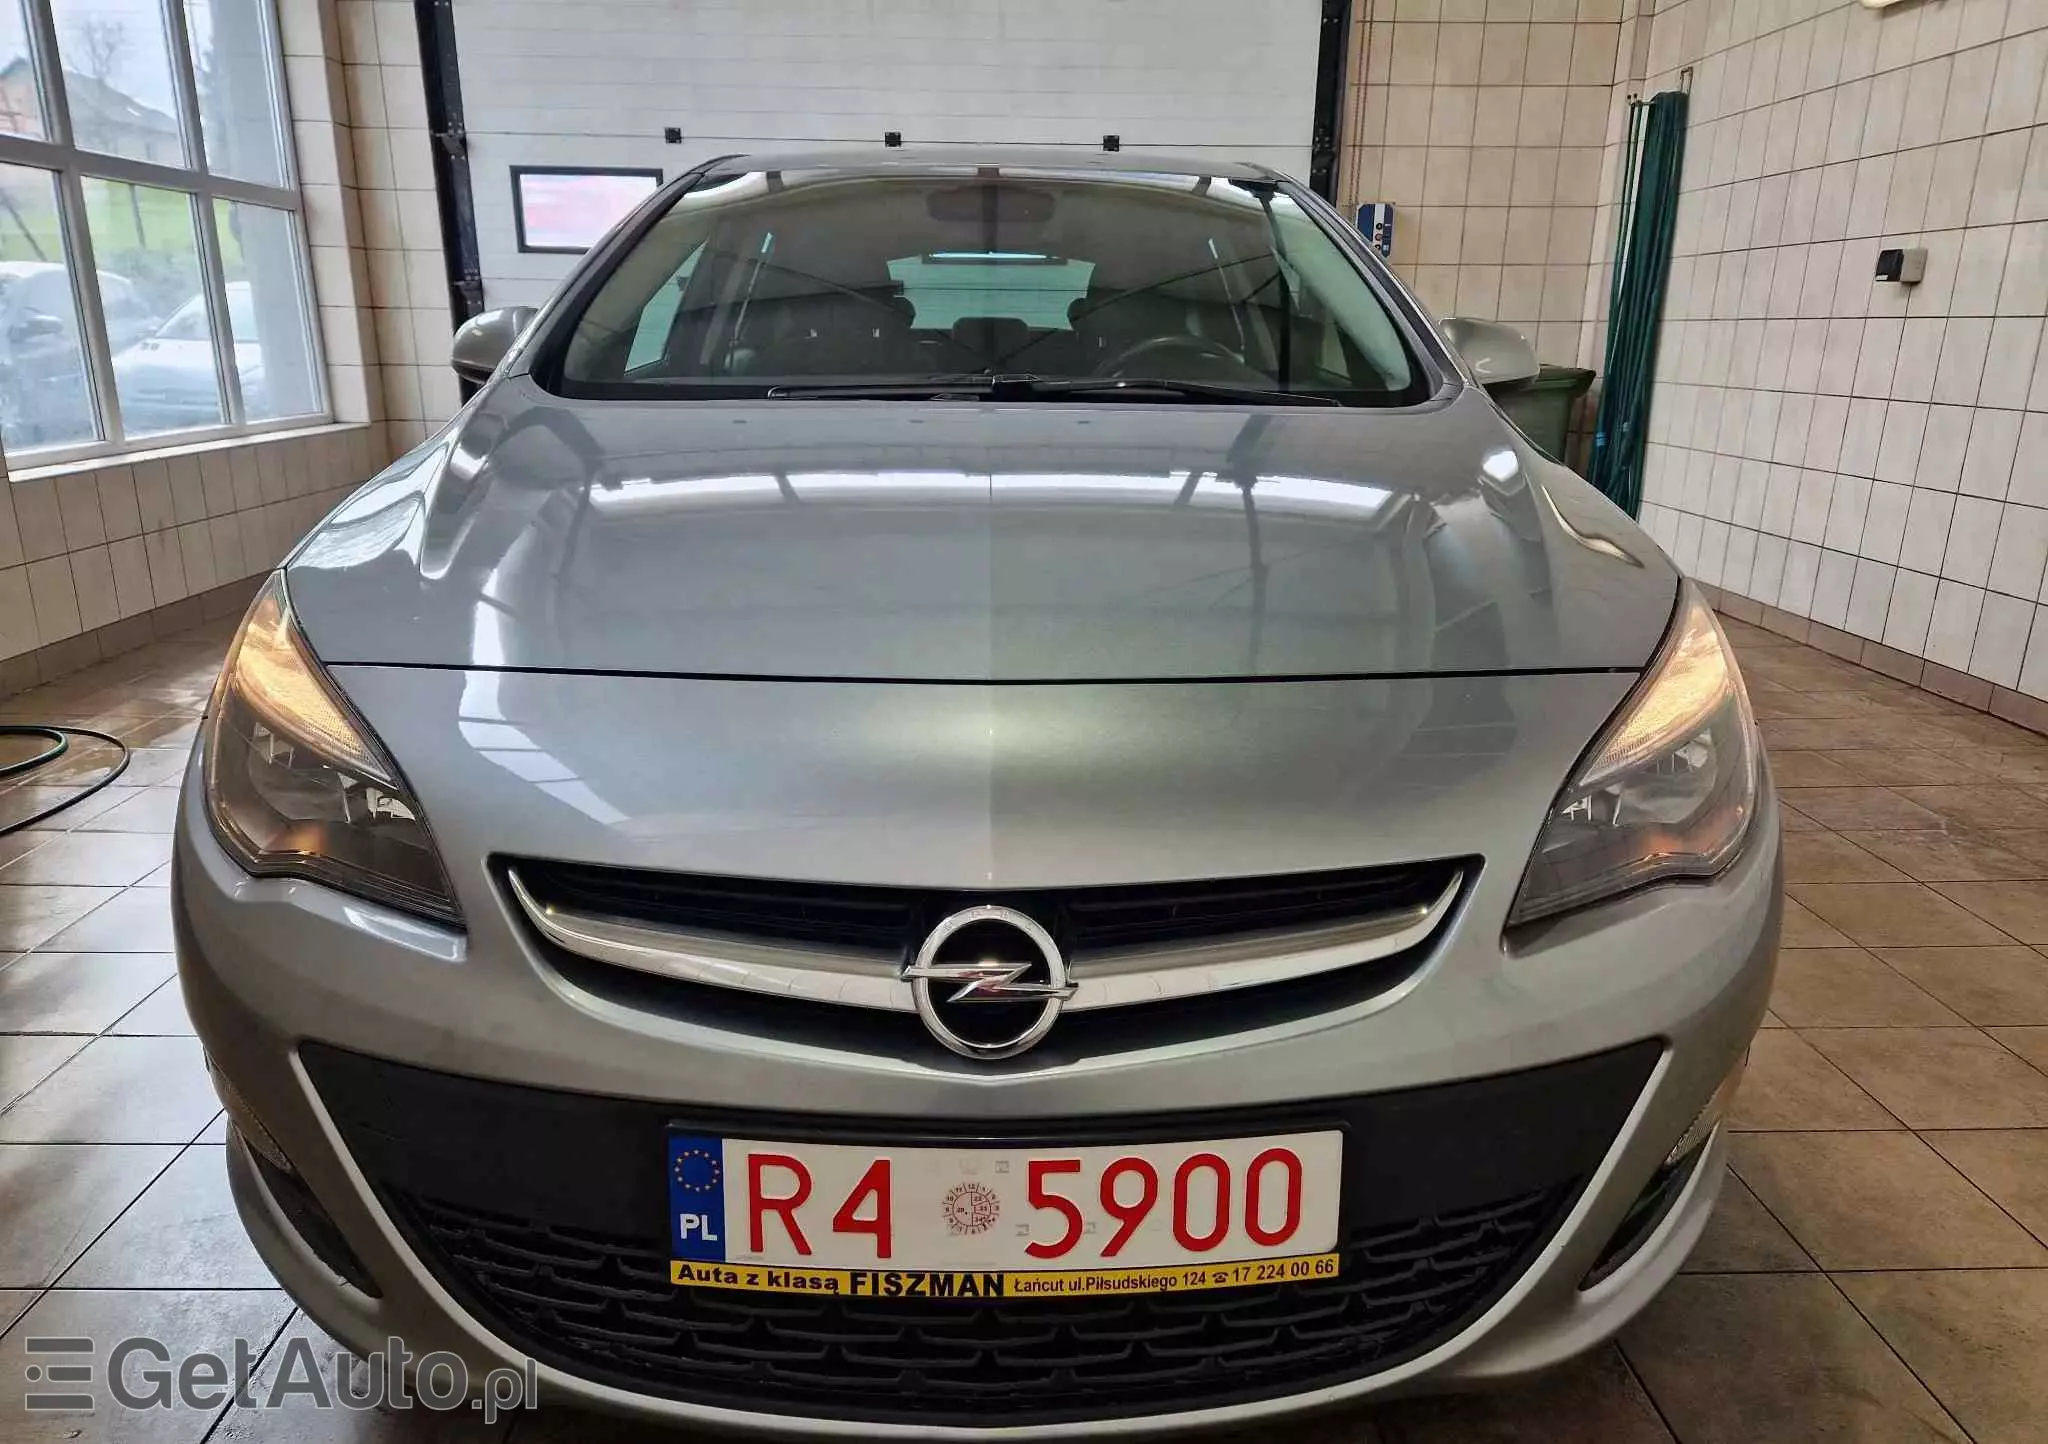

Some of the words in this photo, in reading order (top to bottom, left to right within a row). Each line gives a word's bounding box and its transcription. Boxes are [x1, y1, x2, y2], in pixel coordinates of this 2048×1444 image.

[747, 1154, 892, 1259] R4
[1024, 1148, 1302, 1259] 5900
[679, 1213, 718, 1241] PL
[678, 1264, 738, 1284] Auta
[746, 1273, 760, 1286] z
[768, 1271, 840, 1294] klasą
[850, 1272, 1004, 1296] FISZMAN
[1014, 1278, 1064, 1292] Łańcut
[1182, 1271, 1206, 1286] 124
[1233, 1267, 1250, 1283] 17
[1256, 1264, 1285, 1280] 224
[1290, 1261, 1309, 1277] 00
[1315, 1259, 1334, 1274] 66
